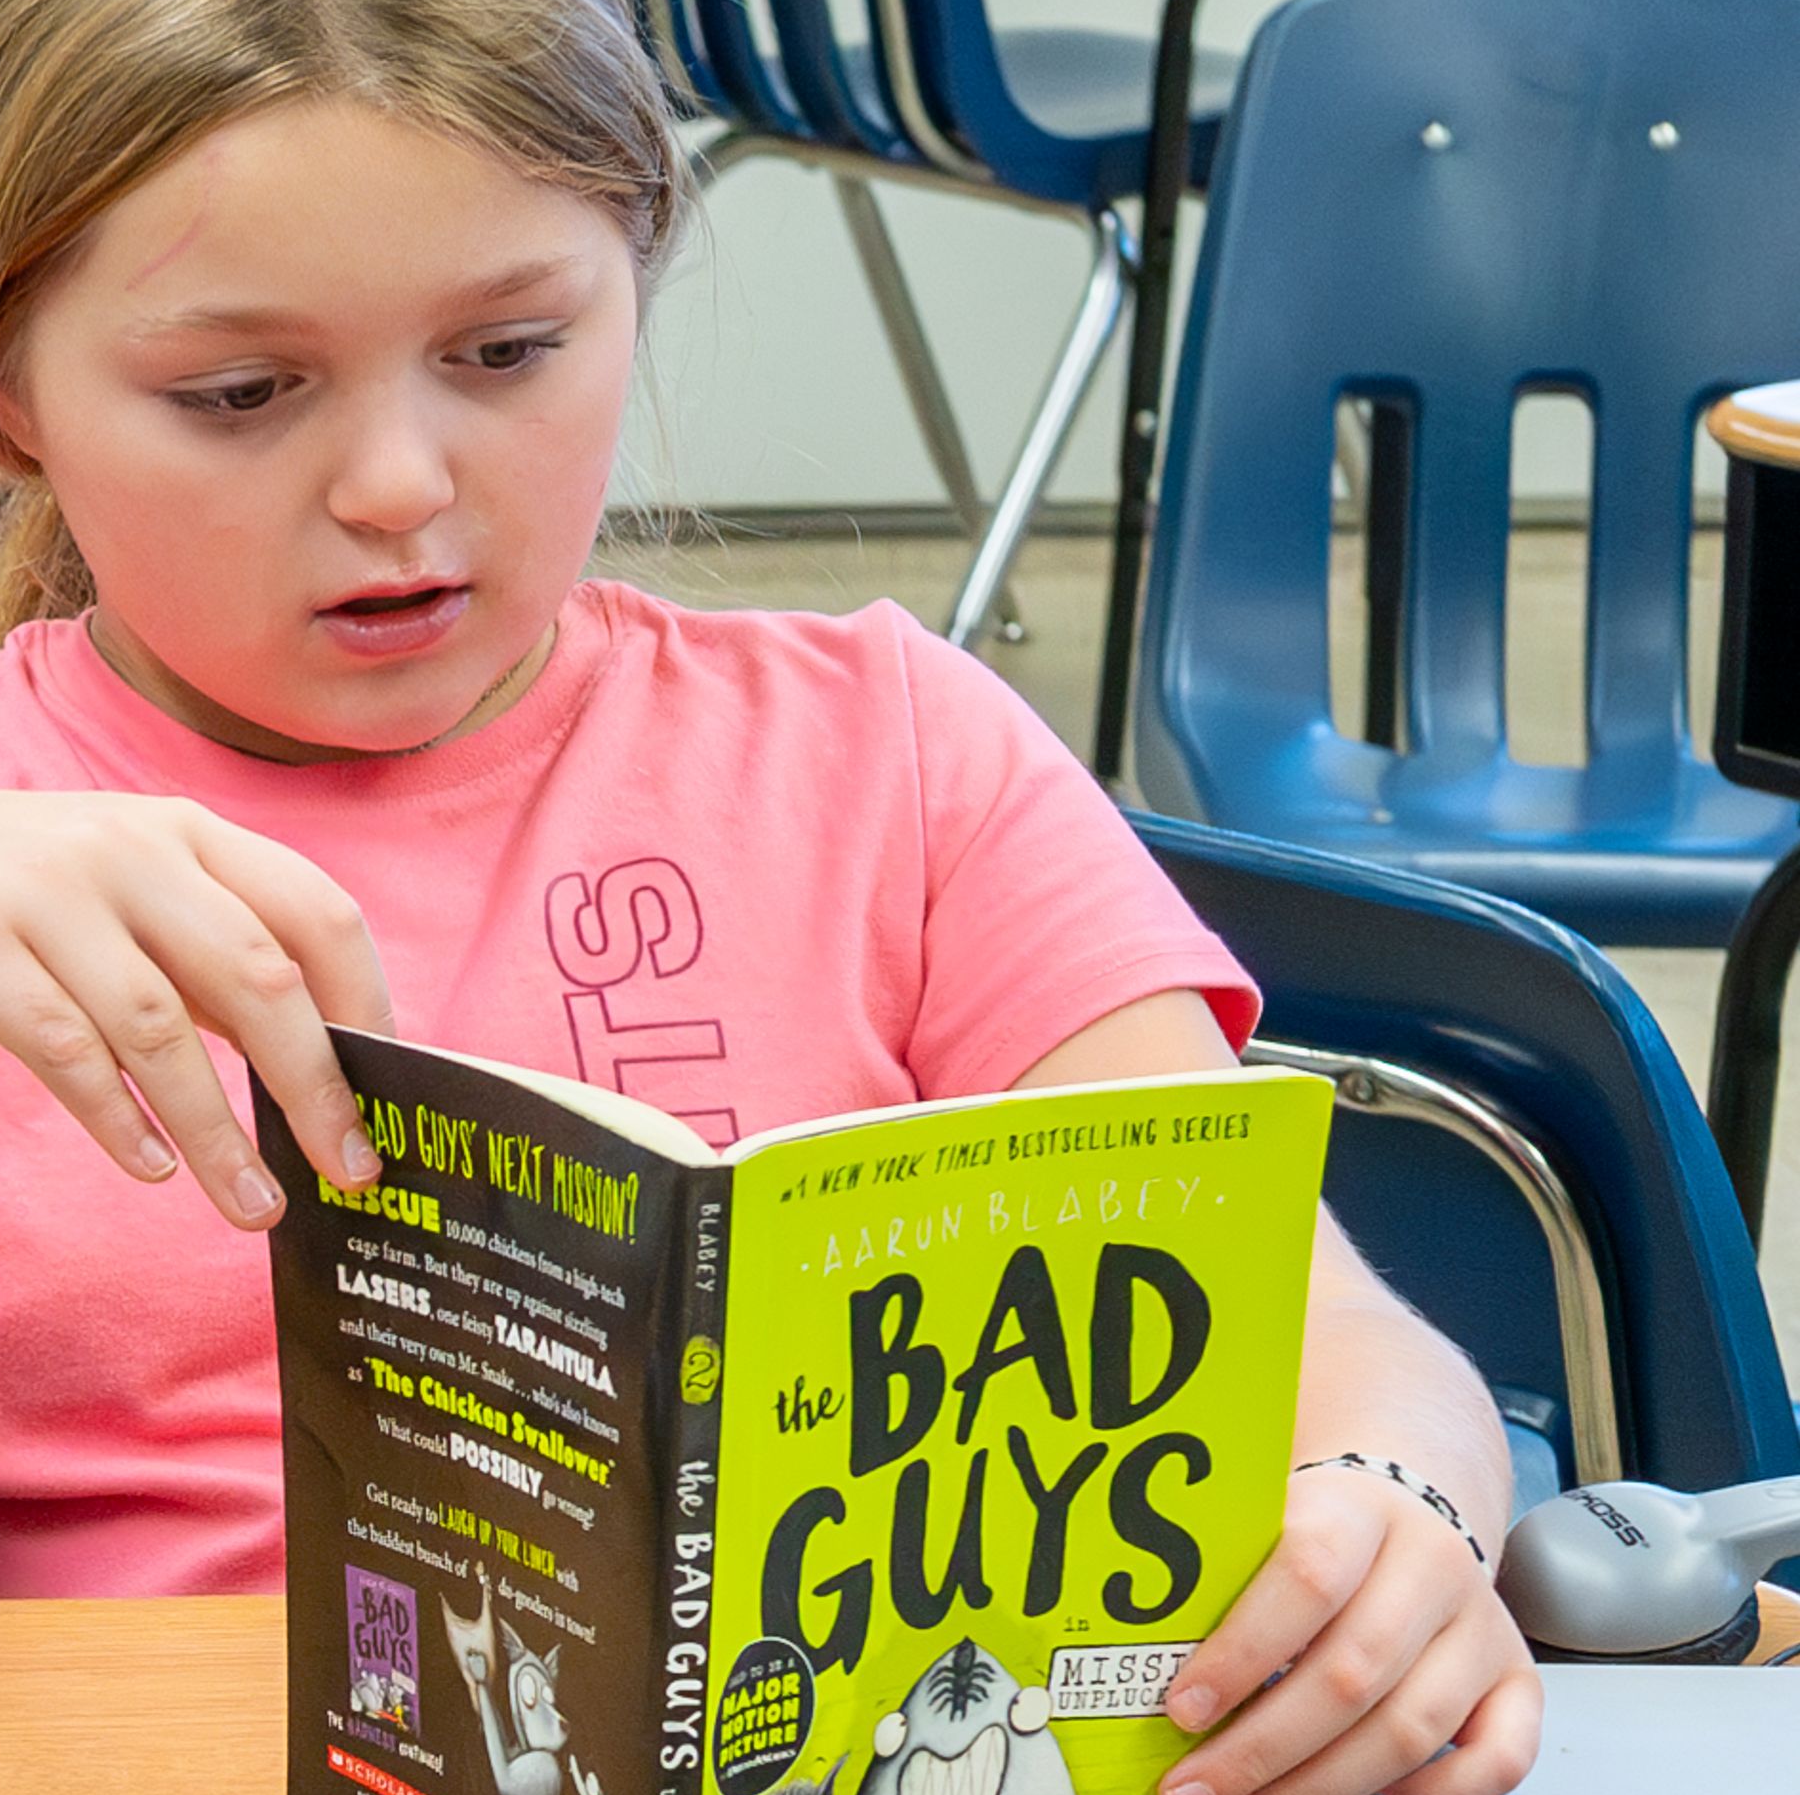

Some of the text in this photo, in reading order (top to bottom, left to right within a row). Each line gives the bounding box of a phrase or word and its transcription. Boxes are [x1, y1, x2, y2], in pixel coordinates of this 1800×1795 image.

[355, 1093, 406, 1160] AD
[416, 1104, 477, 1179] GUYS'
[488, 1130, 544, 1204] NEXT
[817, 1161, 866, 1197] NEW
[871, 1149, 927, 1184] YORK
[934, 1137, 998, 1174] TIMES
[1007, 1117, 1159, 1162] BESTSELLING
[1171, 1111, 1252, 1144] SERIES
[988, 1174, 1202, 1236] BLABEY
[347, 1235, 379, 1261] cage
[382, 1238, 421, 1270] farm.
[424, 1253, 448, 1278] But
[451, 1259, 481, 1294] they
[482, 1273, 503, 1298] are
[505, 1286, 522, 1309] up
[523, 1294, 563, 1325] against
[446, 1219, 487, 1251] 10,000
[488, 1233, 536, 1268] chickens
[537, 1251, 565, 1282] from
[573, 1267, 626, 1310] high-tech
[335, 1263, 436, 1322] LASERS,
[436, 1307, 460, 1327] one
[493, 1313, 618, 1400] TARANTULA,
[339, 1316, 365, 1338] and
[366, 1322, 397, 1348] their
[399, 1336, 427, 1363] very
[429, 1347, 457, 1367] own
[458, 1351, 478, 1377] Mr.
[480, 1361, 515, 1393] Snake
[773, 1241, 1213, 1479] the BAD
[347, 1365, 363, 1383] as
[419, 1375, 508, 1437] Chicken
[376, 1413, 411, 1444] What
[413, 1430, 447, 1457] could
[450, 1431, 543, 1498] POSSIBLY
[659, 1203, 721, 1771] BLABEY 2 the BAD GUYS
[366, 1482, 389, 1507] Get
[390, 1496, 423, 1525] ready
[425, 1506, 438, 1525] to
[1575, 1490, 1645, 1546] KOSS
[347, 1517, 368, 1540] the
[415, 1540, 452, 1574] bunch
[454, 1558, 469, 1579] of
[761, 1424, 1213, 1677] GUYS
[362, 1586, 409, 1637] BAD
[1063, 1616, 1091, 1632] in
[353, 1622, 412, 1676] GUYS
[1060, 1653, 1187, 1686] MISSI
[721, 1697, 799, 1745] MOTION
[722, 1672, 800, 1721] MAJOR
[719, 1723, 797, 1768] PICTURE
